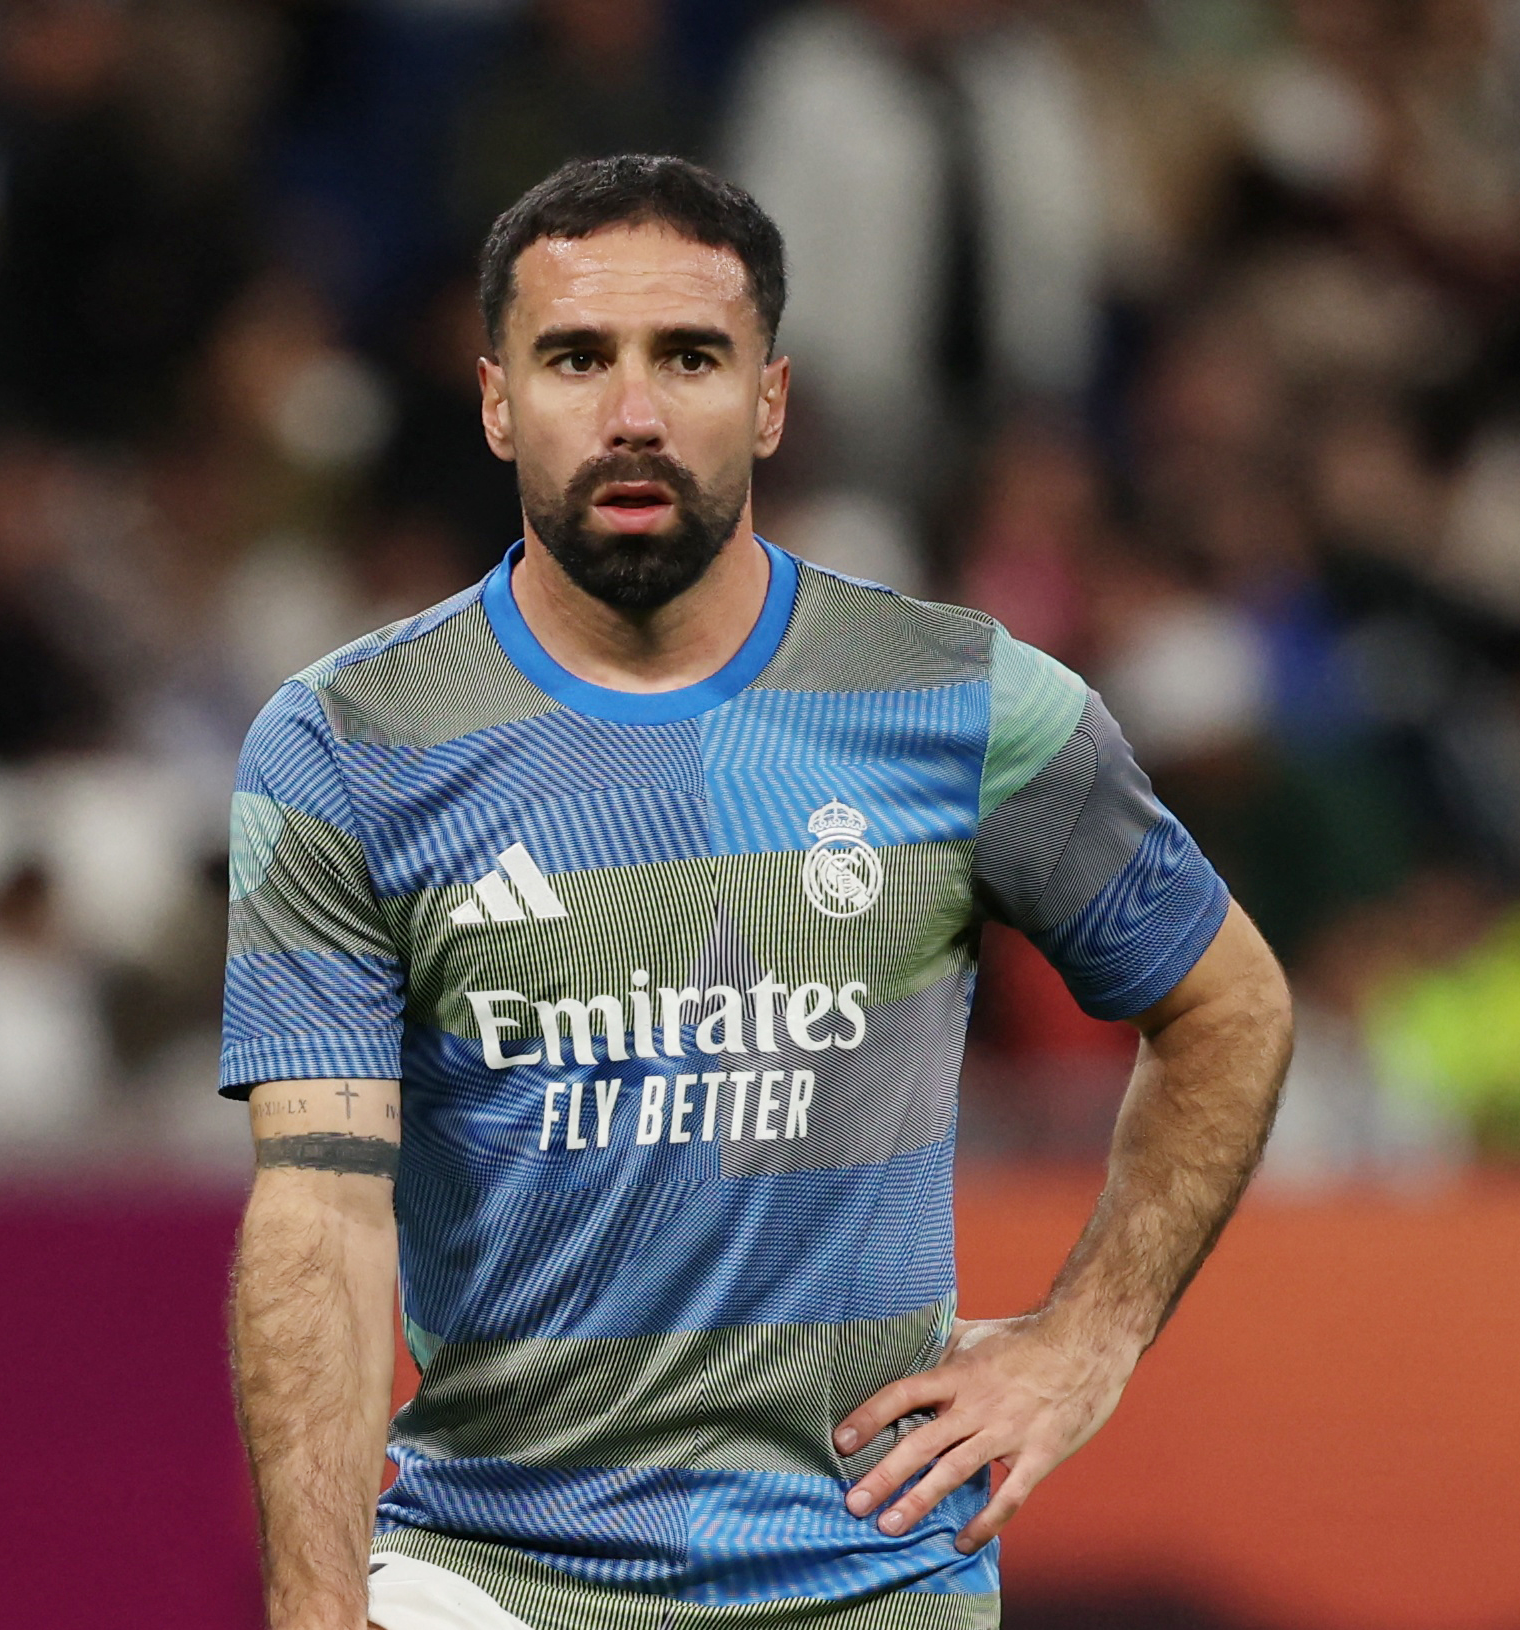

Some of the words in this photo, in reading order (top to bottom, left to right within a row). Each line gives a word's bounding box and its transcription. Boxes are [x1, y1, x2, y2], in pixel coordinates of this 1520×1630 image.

[464, 969, 867, 1070] Emirates
[539, 1078, 622, 1151] FLY
[636, 1070, 816, 1146] BETTER
